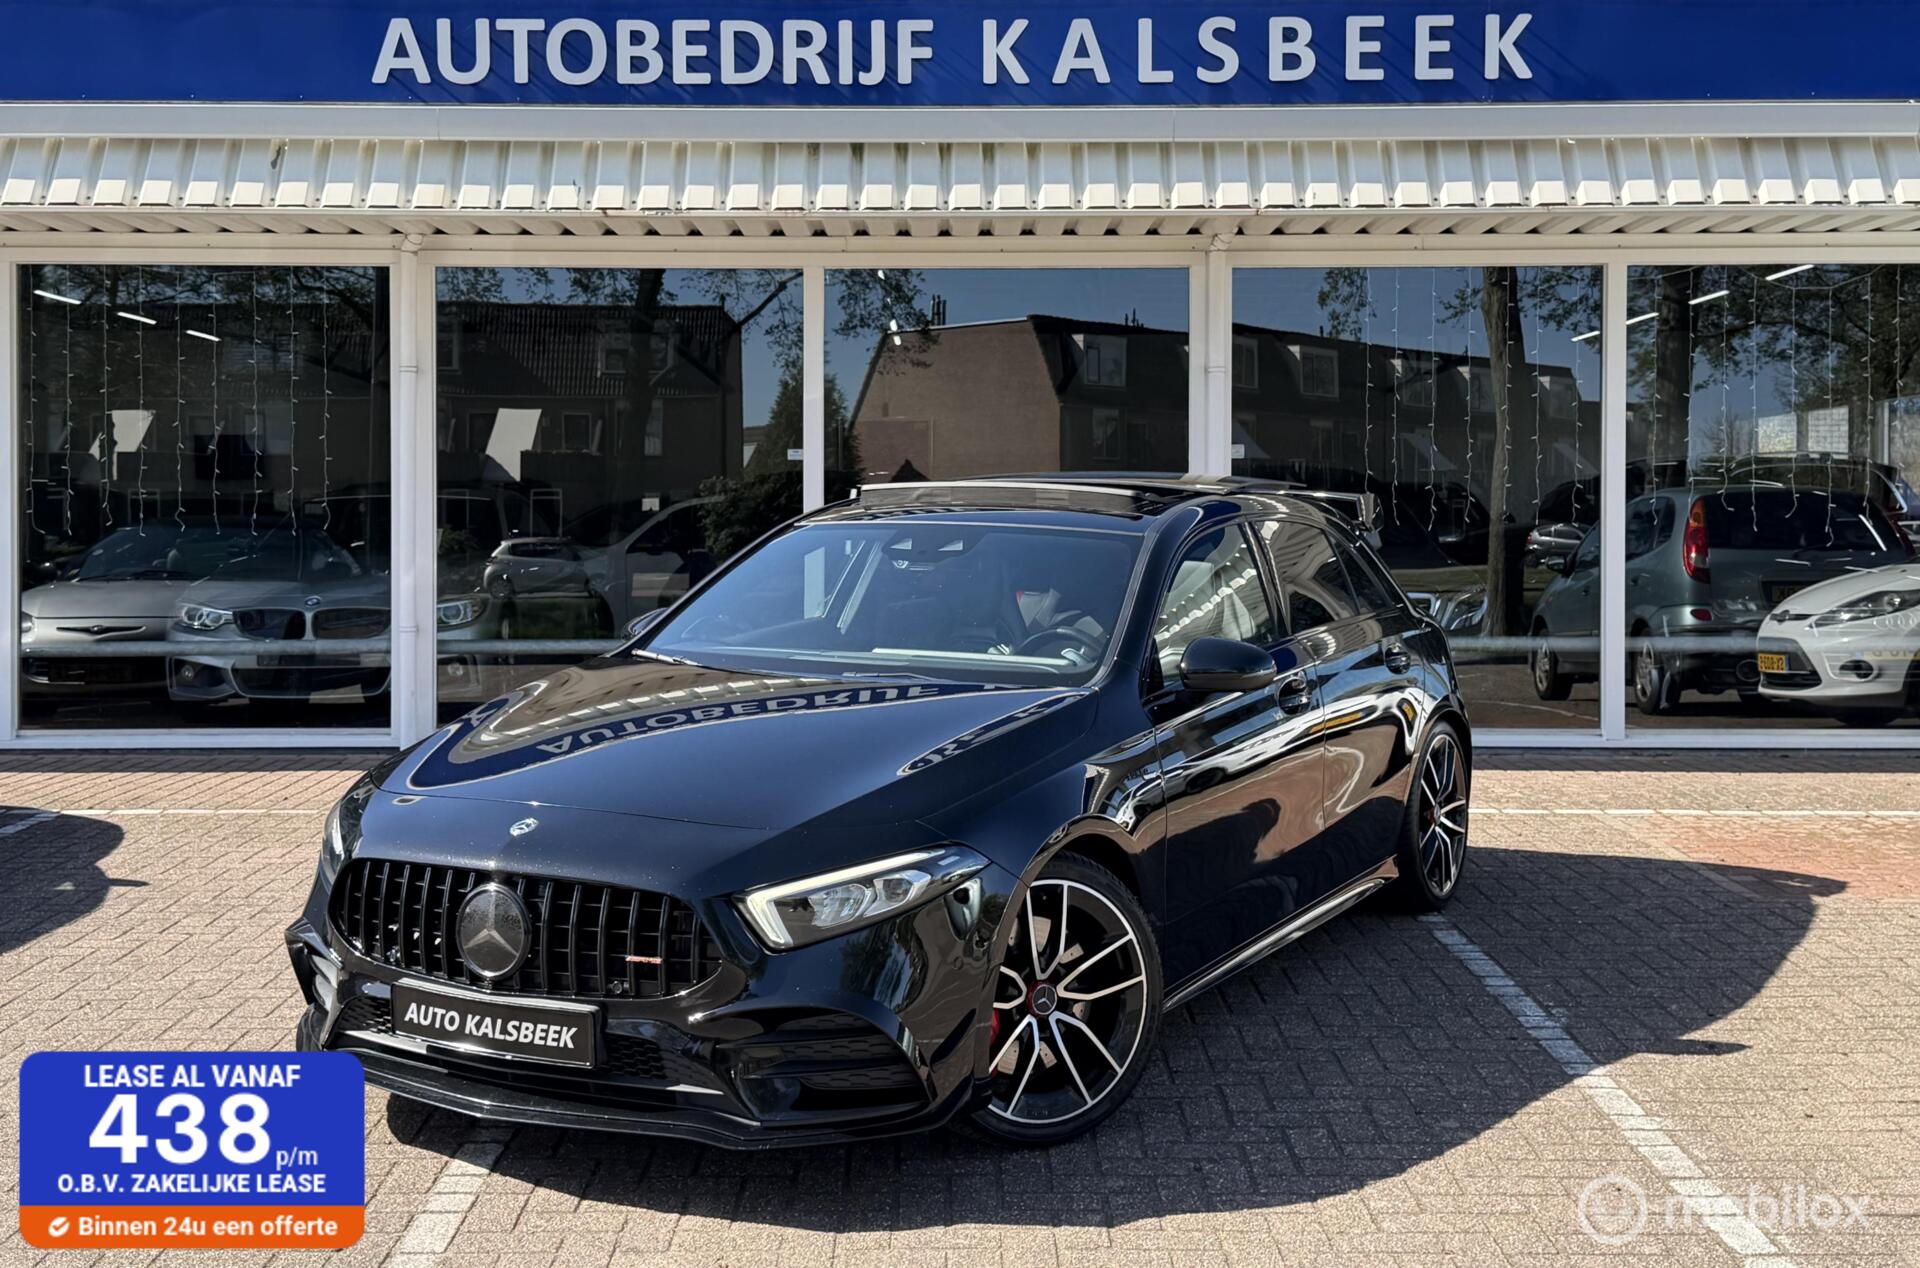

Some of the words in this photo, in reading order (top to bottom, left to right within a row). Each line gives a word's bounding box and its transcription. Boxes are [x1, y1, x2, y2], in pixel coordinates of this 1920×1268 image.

[372, 18, 933, 85] AUTOBEDRIJF
[982, 13, 1534, 85] KALSBEEK
[404, 1003, 460, 1031] AUTO
[464, 1014, 578, 1049] KALSBEEK
